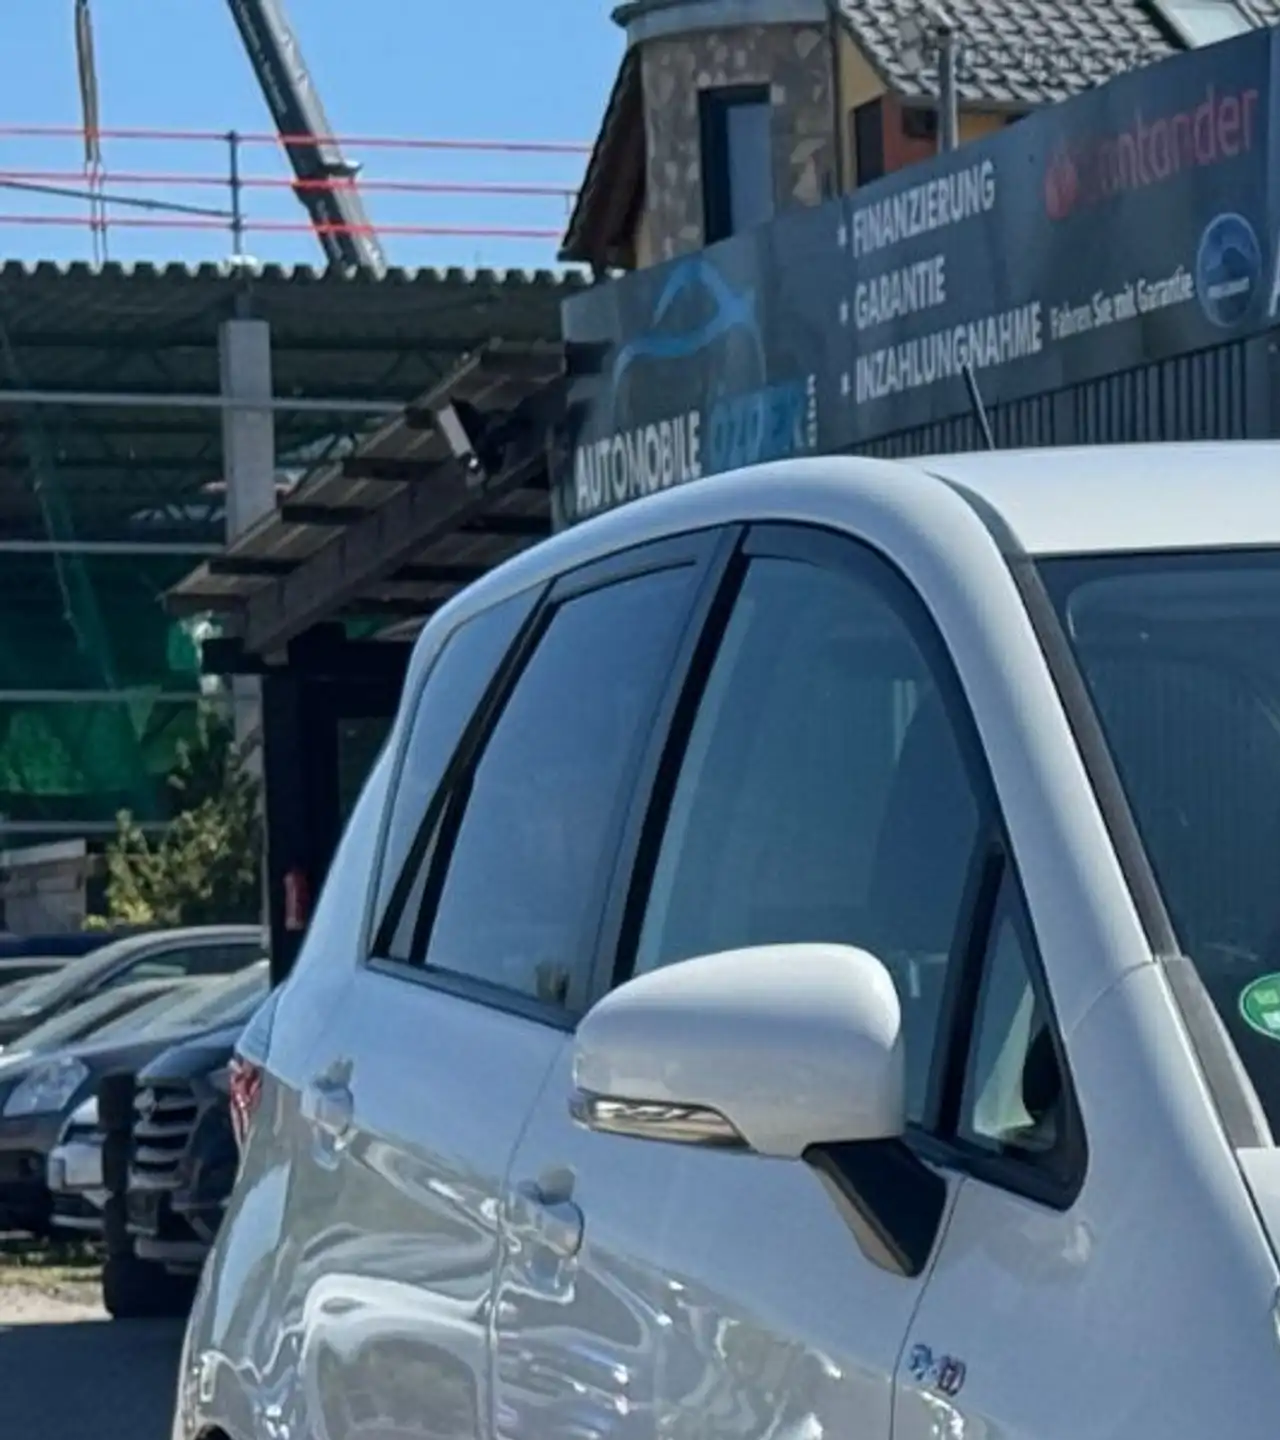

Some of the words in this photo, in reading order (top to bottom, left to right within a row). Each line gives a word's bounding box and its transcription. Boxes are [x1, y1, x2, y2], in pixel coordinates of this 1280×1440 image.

[853, 160, 996, 258] FINANZIERUNG
[854, 254, 946, 330] GARANTIE
[856, 300, 1043, 404] INZAHLUNGNAHME
[575, 409, 703, 514] AUTOMOBILE
